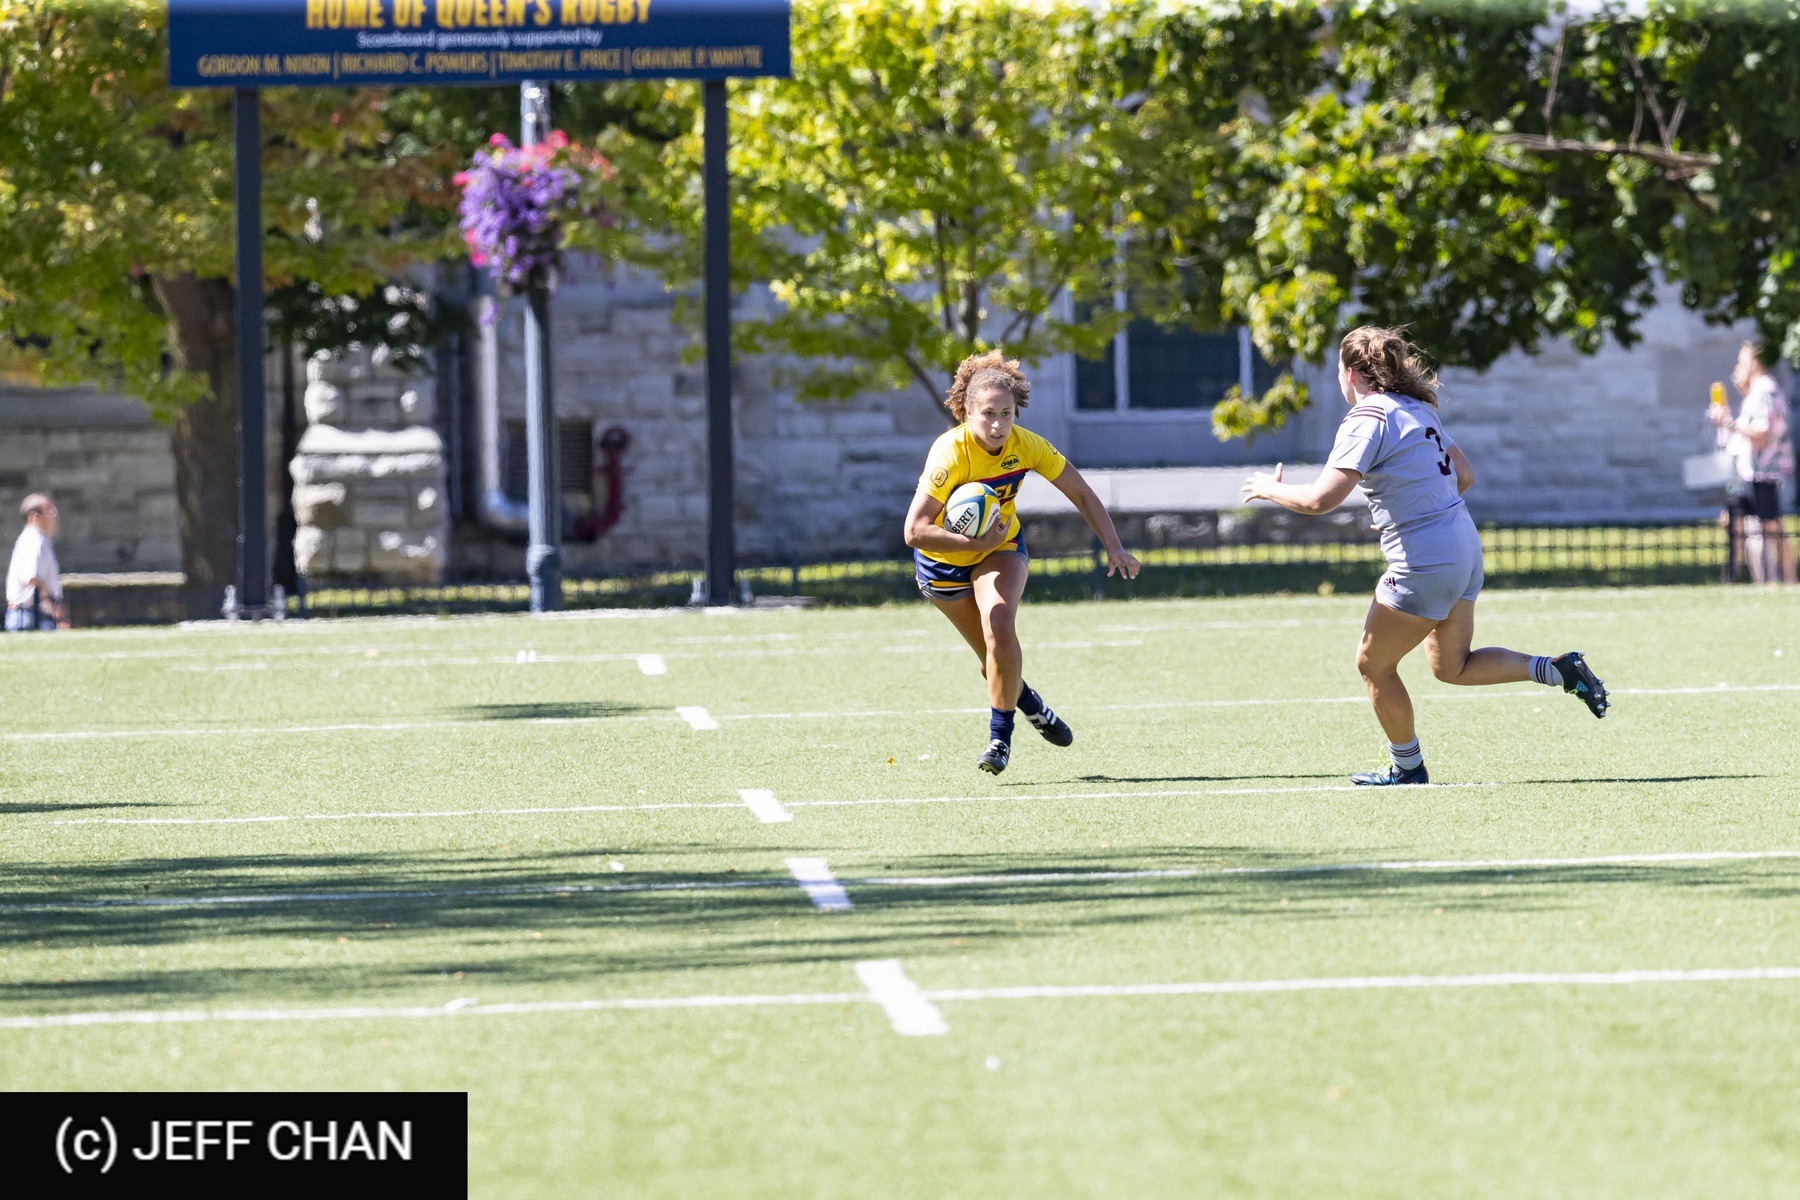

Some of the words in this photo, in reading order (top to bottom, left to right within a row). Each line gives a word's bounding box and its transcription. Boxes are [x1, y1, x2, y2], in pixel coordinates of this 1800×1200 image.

[306, 0, 384, 29] HOME
[393, 0, 427, 28] OF
[561, 0, 650, 26] RUGBY
[197, 54, 260, 77] GORDON
[1425, 427, 1452, 476] 3
[950, 507, 975, 534] BERT
